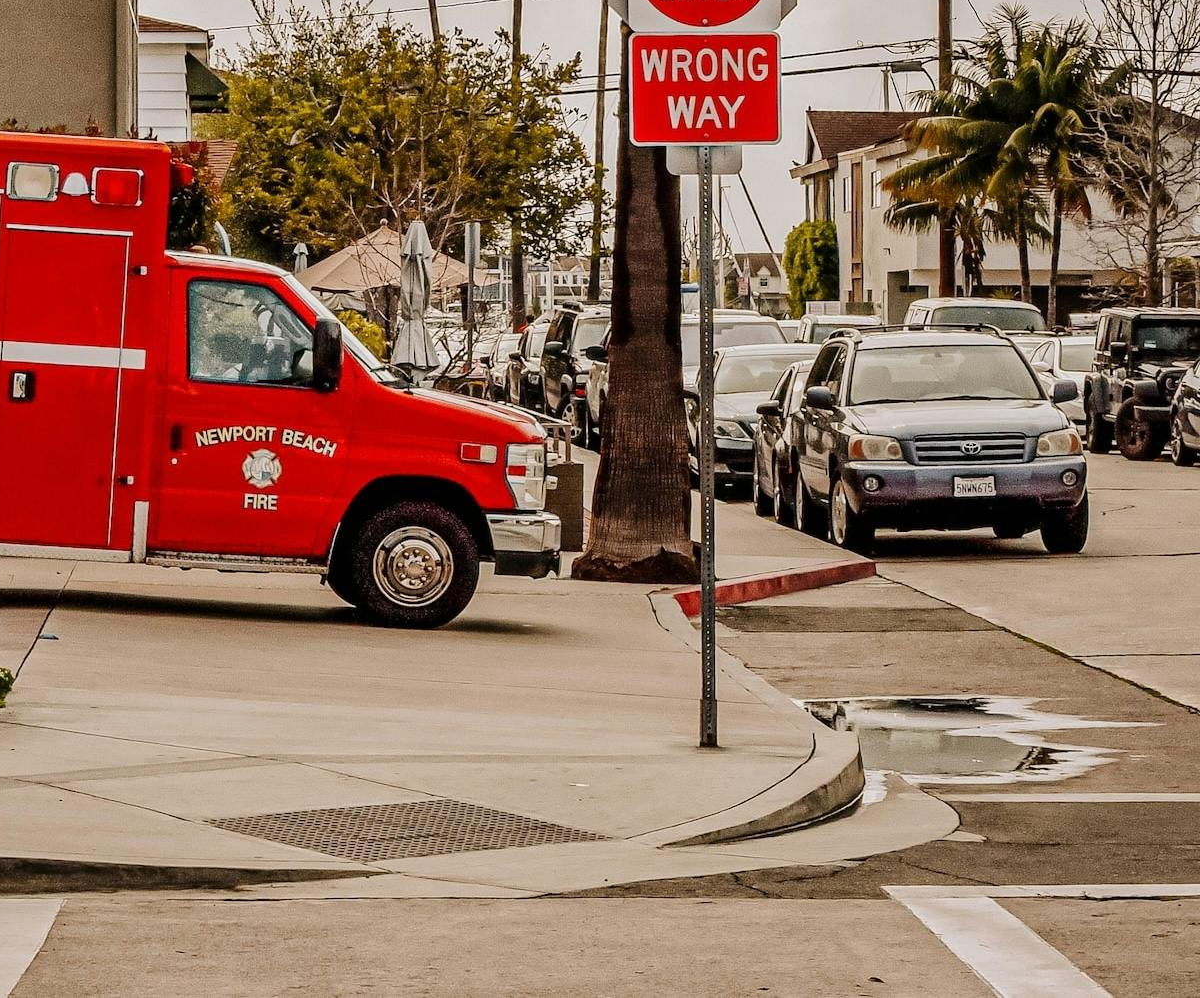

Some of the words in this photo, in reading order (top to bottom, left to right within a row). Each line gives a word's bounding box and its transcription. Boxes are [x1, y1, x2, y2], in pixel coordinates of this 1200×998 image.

[640, 47, 769, 82] WRONG
[667, 95, 745, 129] WAY
[196, 426, 277, 447] NEWPORT
[282, 429, 337, 458] BEACH
[244, 493, 278, 510] FIRE
[957, 483, 993, 493] 5NWN675
